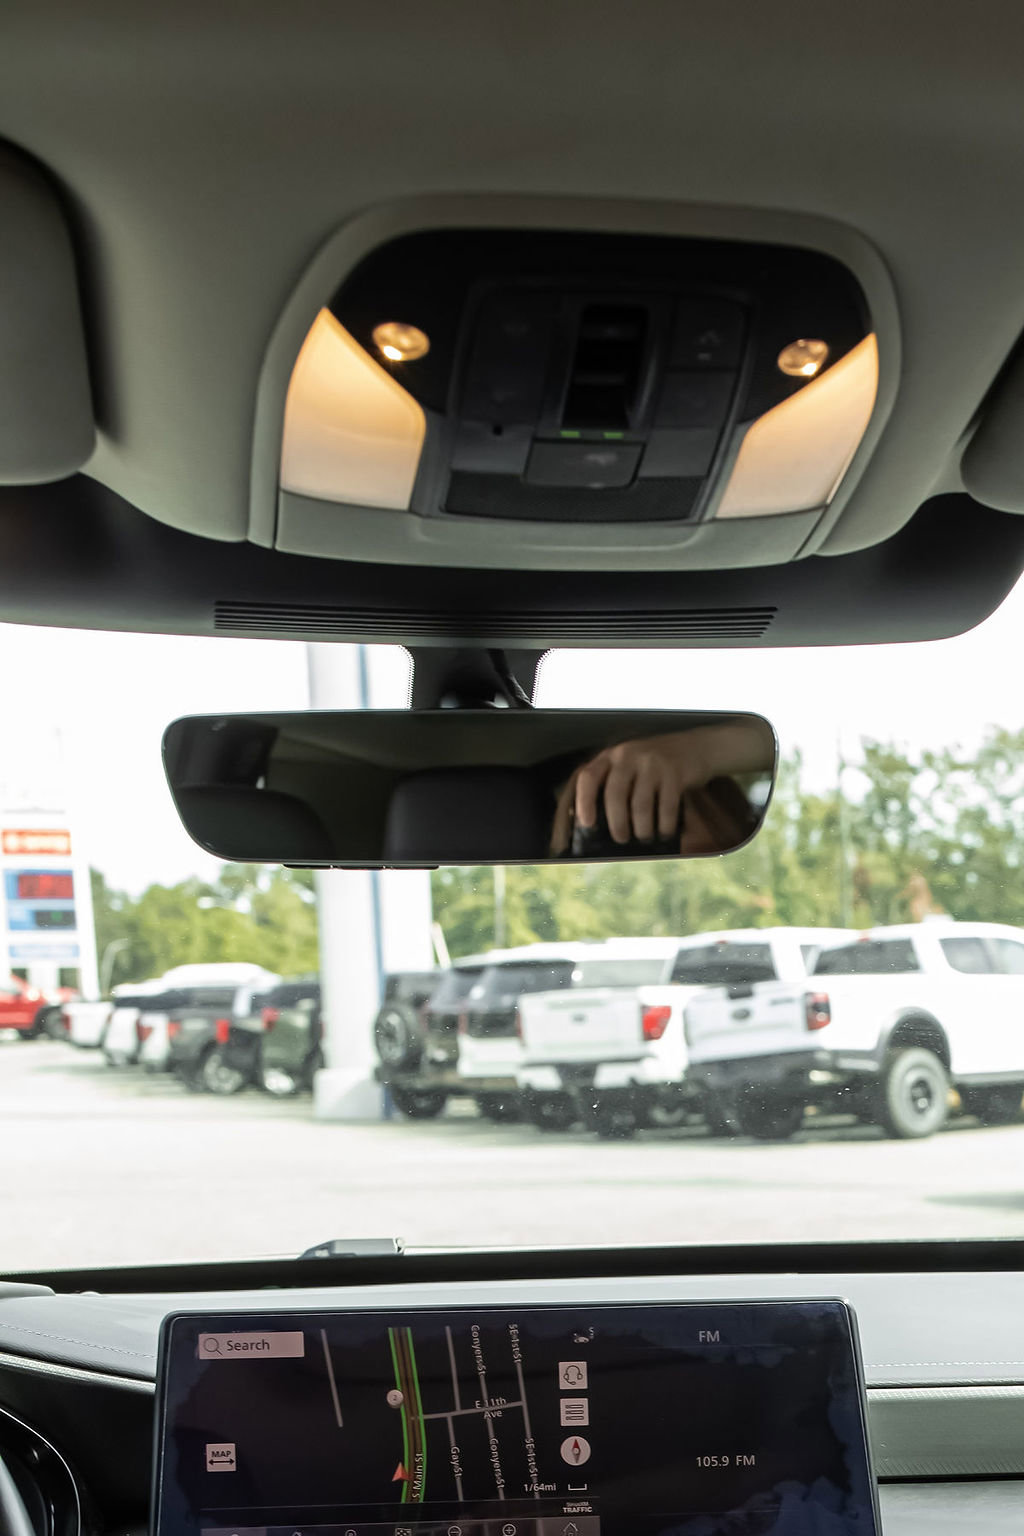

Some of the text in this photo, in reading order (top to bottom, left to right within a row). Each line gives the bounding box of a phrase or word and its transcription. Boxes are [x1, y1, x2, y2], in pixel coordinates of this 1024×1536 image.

[699, 1330, 720, 1343] FM
[226, 1339, 270, 1351] Search
[471, 1324, 482, 1363] Conyers
[475, 1400, 481, 1409] E
[484, 1410, 503, 1419] Ave
[414, 1453, 424, 1463] St
[450, 1446, 463, 1478] Gay St
[489, 1438, 502, 1477] Conyers
[696, 1455, 755, 1467] 105.9 FM
[412, 1465, 423, 1490] Main
[523, 1482, 557, 1492] 1/64mi
